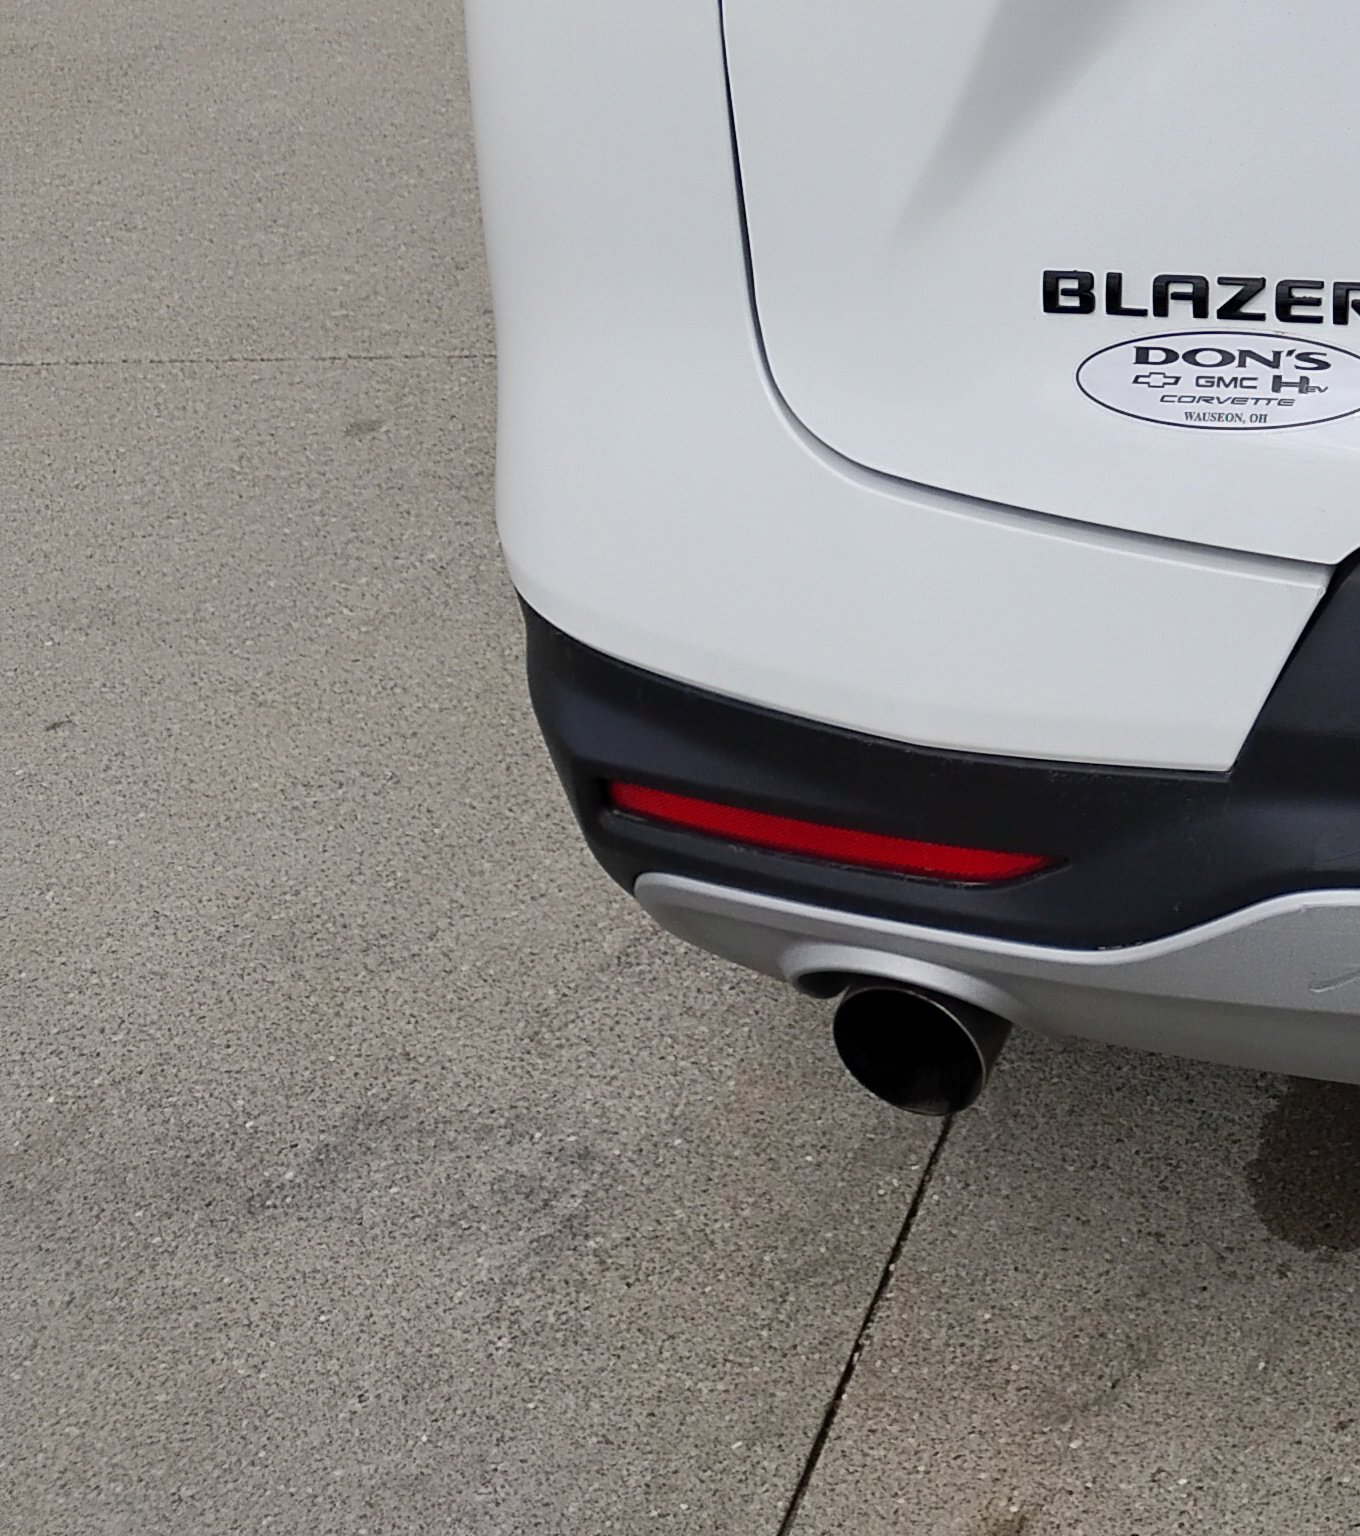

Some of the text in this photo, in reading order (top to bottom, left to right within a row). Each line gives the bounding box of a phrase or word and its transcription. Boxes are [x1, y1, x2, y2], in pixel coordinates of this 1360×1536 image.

[1133, 345, 1332, 372] DON'S
[1195, 375, 1259, 390] GMC
[1159, 394, 1296, 407] CORVETTE
[1184, 411, 1269, 425] WAUSEON, OH
